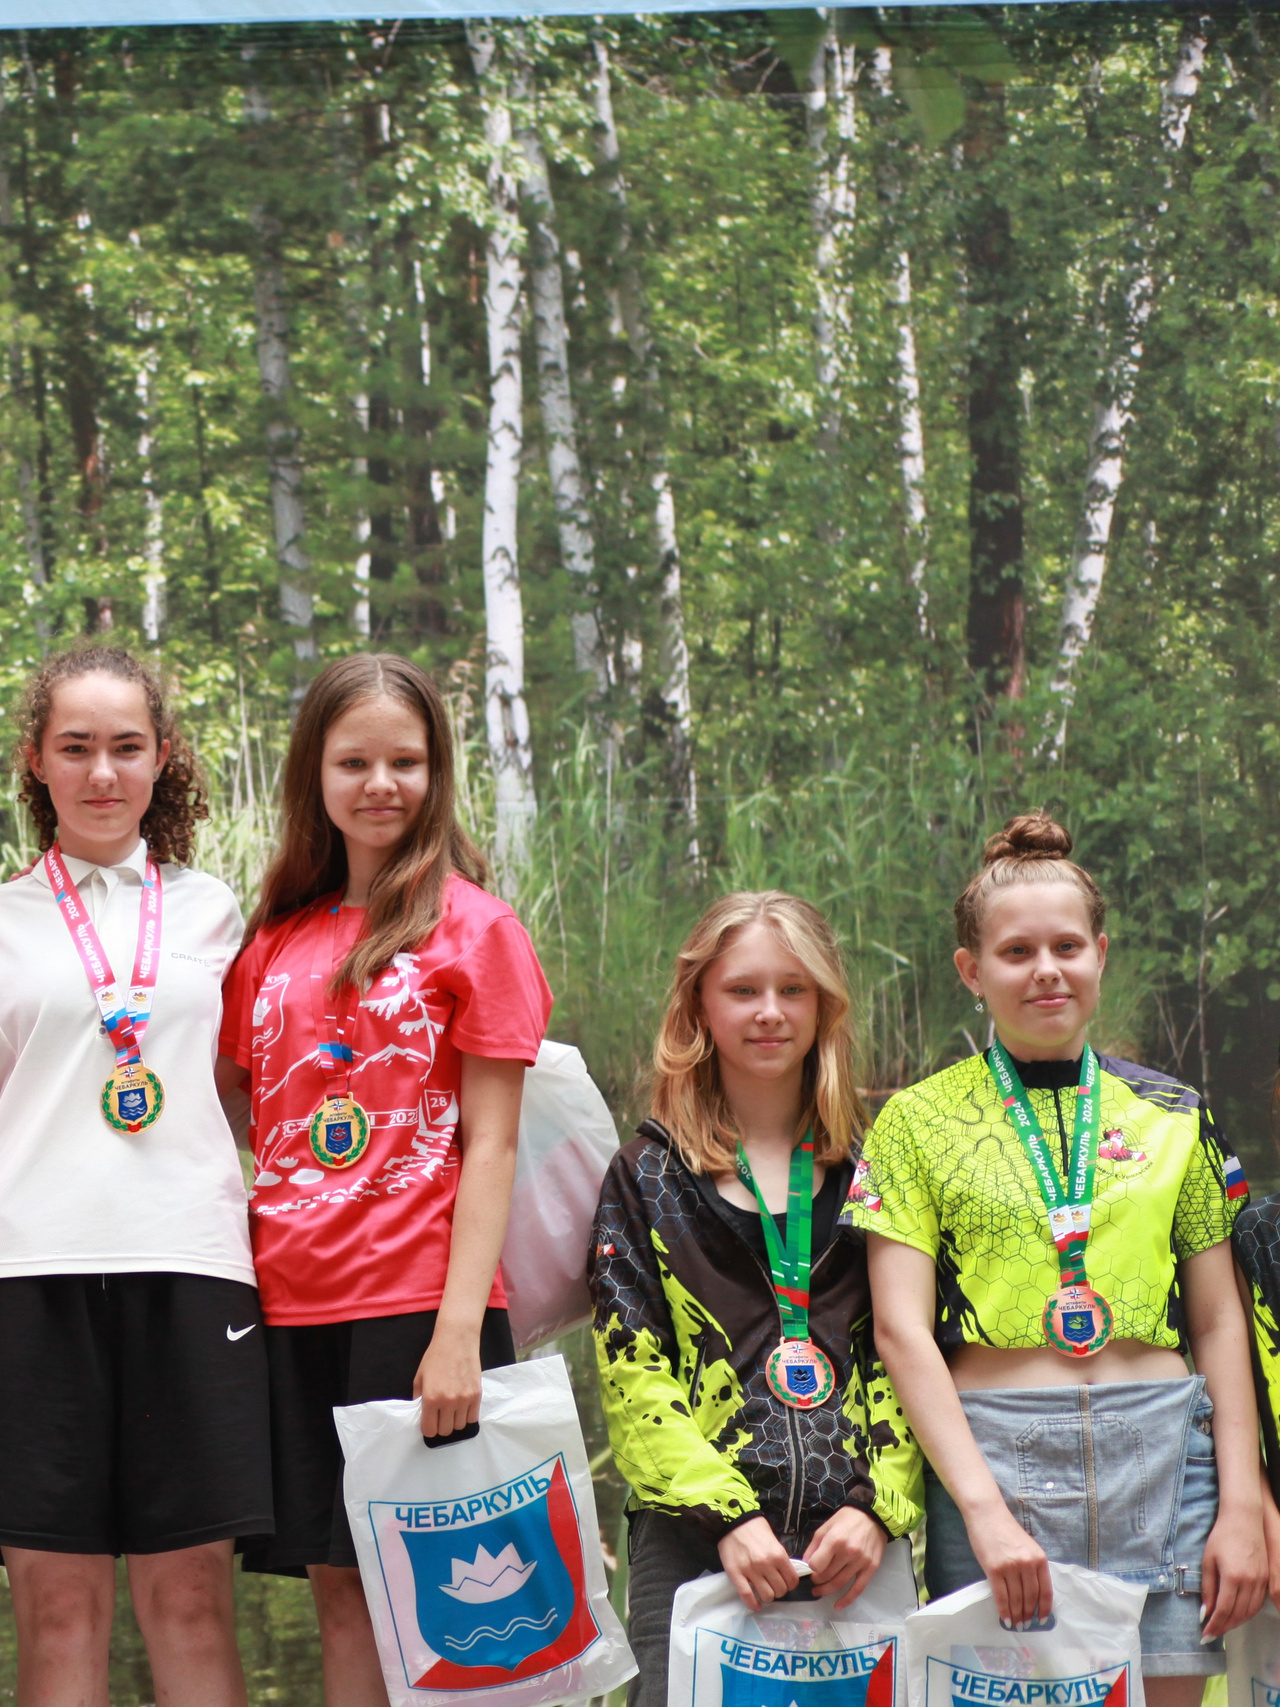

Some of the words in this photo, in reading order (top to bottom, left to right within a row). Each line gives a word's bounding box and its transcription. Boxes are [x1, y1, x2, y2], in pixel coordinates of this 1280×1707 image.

[63, 895, 80, 920] 2024
[147, 889, 157, 914] 2024
[76, 923, 106, 983] ЧЕБАРКУЛЬ
[139, 919, 156, 979] ЧЕБАРКУЛЬ
[990, 1038, 1014, 1093] ЧЕБАРКУ
[1085, 1046, 1100, 1088] ЧЕБАР
[114, 1080, 149, 1091] ЧЕБАРКУЛЬ
[431, 1096, 448, 1108] 28
[1011, 1101, 1031, 1127] 2024
[1082, 1097, 1094, 1124] 2024
[1027, 1133, 1057, 1202] ЧЕБАРКУЛЬ
[1074, 1131, 1091, 1200] ЧЕБАРКУЛЬ
[1058, 1303, 1097, 1312] ЧЕБАРКУЛЬ
[395, 1474, 552, 1529] ЧЕБАРКУЛЬ
[720, 1639, 879, 1678] ЧЕБАРКУЛЬ
[951, 1669, 1114, 1706] ЧЕБАРКУЛЬ
